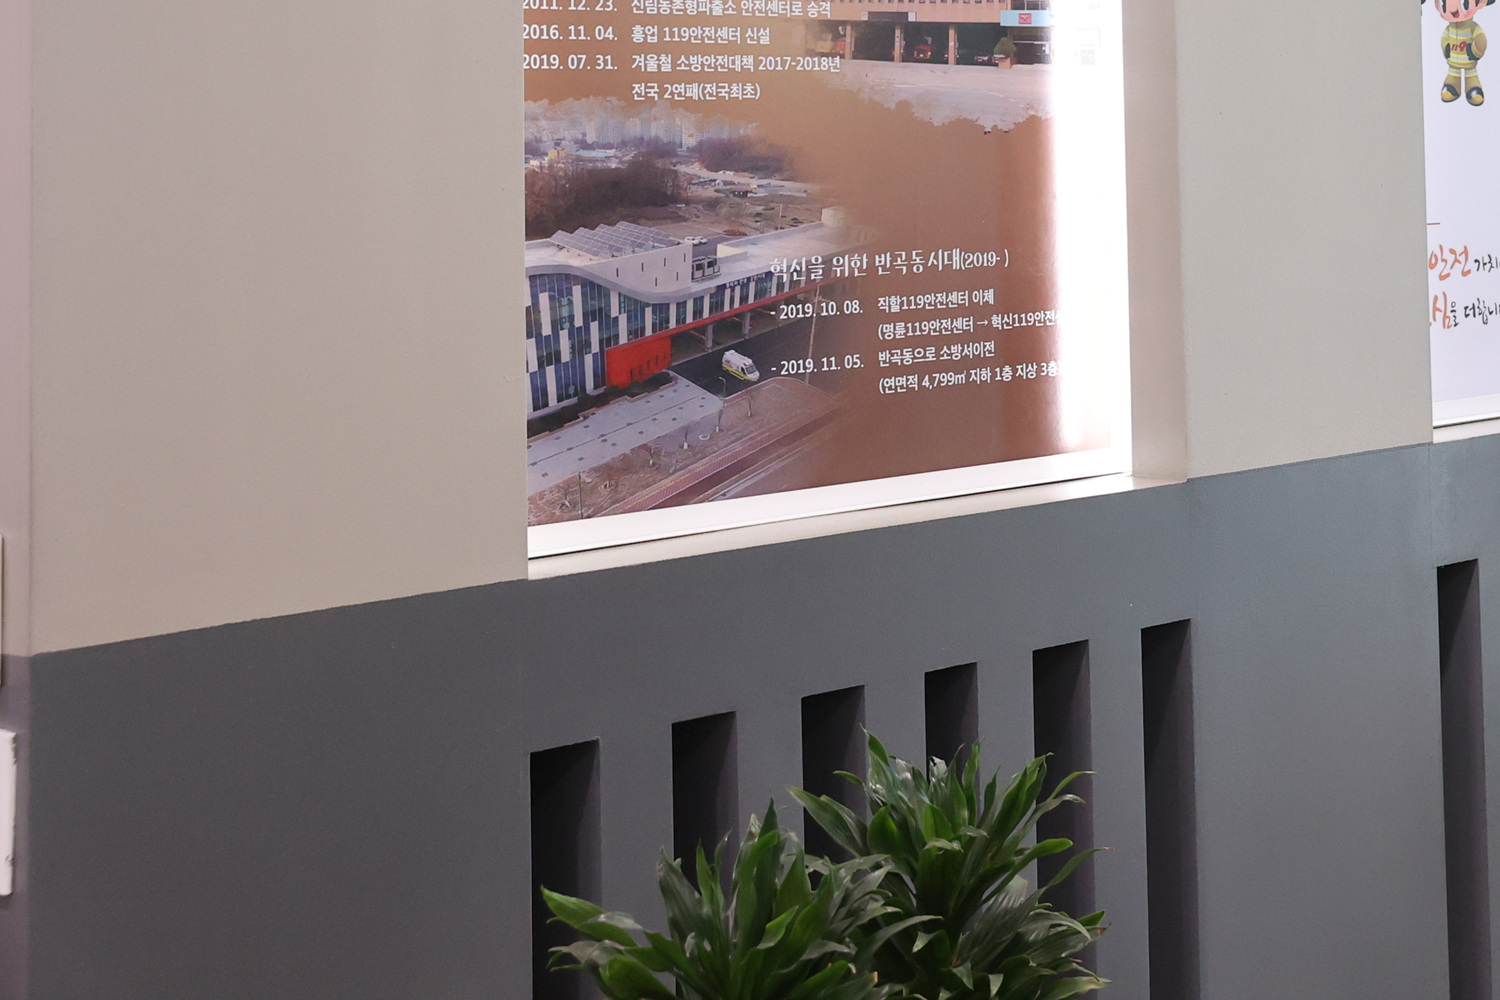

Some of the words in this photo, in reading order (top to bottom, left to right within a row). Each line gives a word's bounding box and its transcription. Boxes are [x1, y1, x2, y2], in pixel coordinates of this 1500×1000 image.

[741, 0, 803, 17] 안전센터로
[807, 1, 831, 18] 승격
[632, 54, 672, 72] 겨울철
[676, 55, 754, 72] 소방안전대책
[758, 57, 840, 72] 2017-2018년
[632, 83, 659, 100] 전국
[770, 254, 825, 282] 혁신을
[833, 254, 868, 278] 위한
[1428, 244, 1471, 281] 안전
[878, 291, 969, 313] 직할119안전센터
[973, 289, 994, 305] 이체
[1430, 292, 1459, 330] 심을
[878, 317, 974, 340] (명륜119안전센터
[879, 347, 937, 367] 반곡동으로
[940, 341, 994, 360] 소방서이전
[879, 376, 918, 394] (연면적
[969, 368, 991, 384] 지하
[995, 365, 1013, 381] 1층
[1016, 364, 1037, 379] 지상
